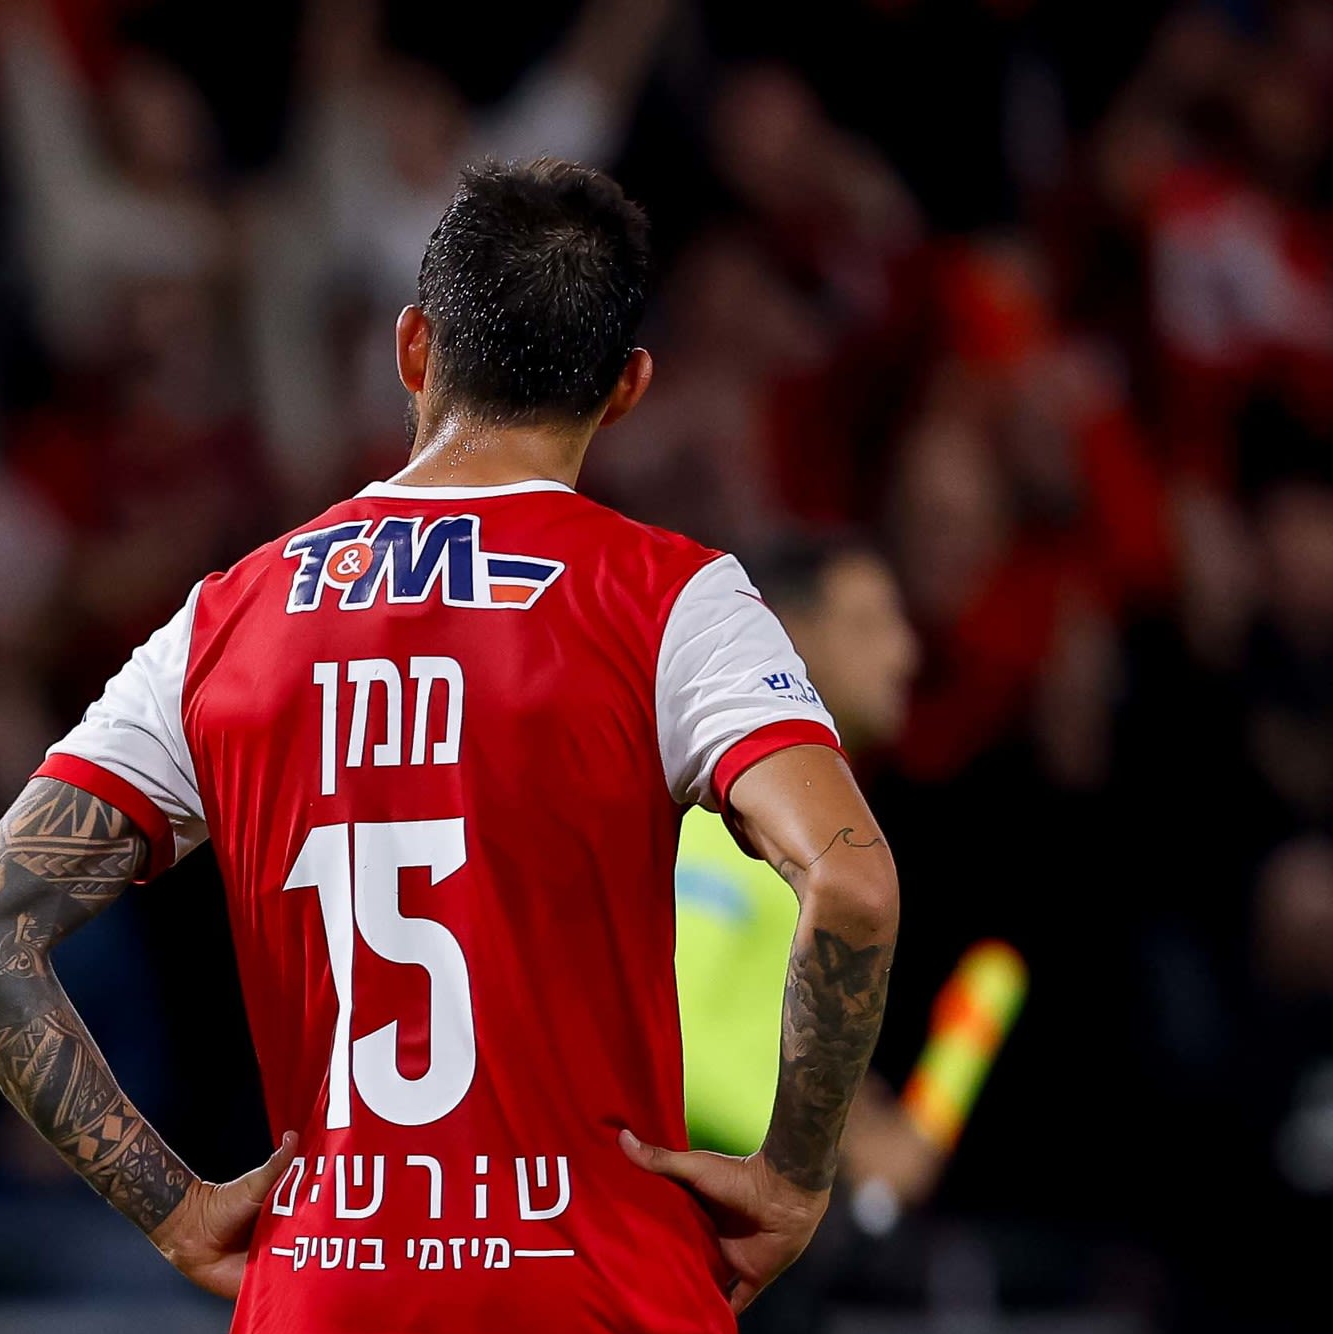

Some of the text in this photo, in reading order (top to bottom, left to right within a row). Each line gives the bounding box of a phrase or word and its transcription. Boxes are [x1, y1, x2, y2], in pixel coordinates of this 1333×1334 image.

[284, 514, 487, 612] T&M
[313, 656, 464, 796] ממן
[283, 816, 476, 1130] 15
[293, 1236, 511, 1272] מיזמי בוטיק
